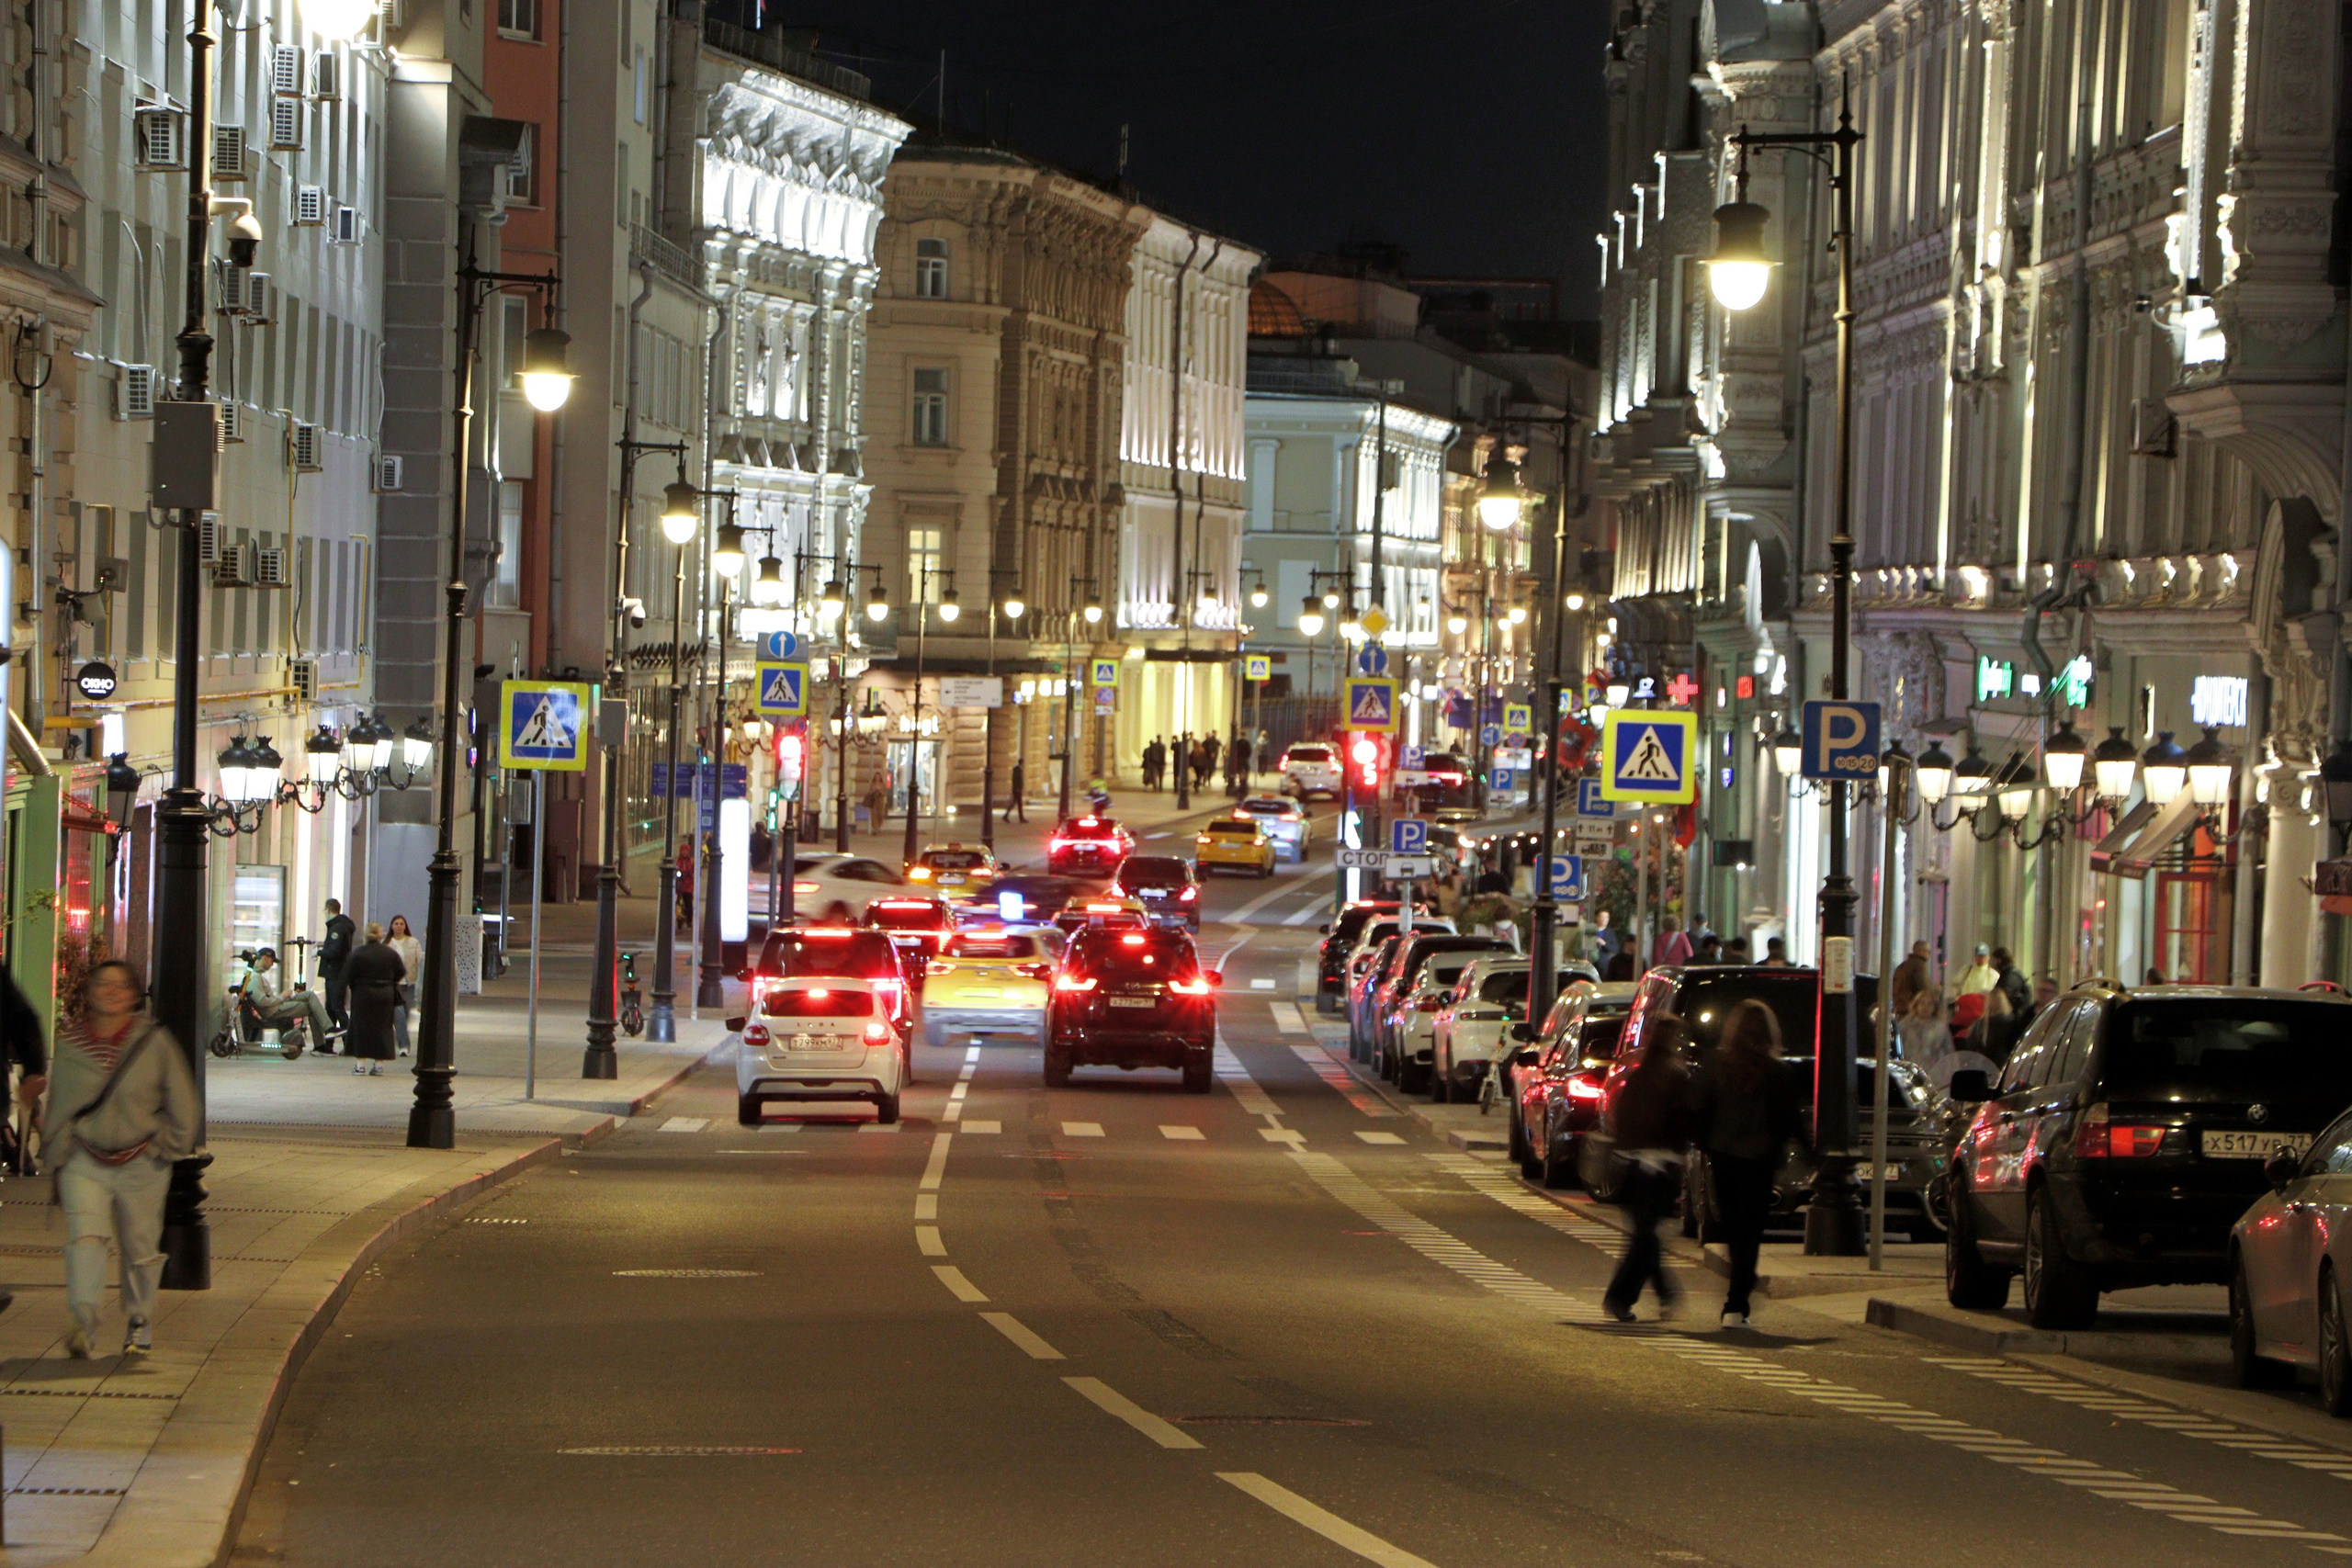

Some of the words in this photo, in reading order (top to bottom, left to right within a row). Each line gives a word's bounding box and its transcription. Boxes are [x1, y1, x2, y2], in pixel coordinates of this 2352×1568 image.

[1819, 705, 1867, 773] P
[1860, 758, 1875, 769] 20
[1401, 823, 1420, 850] P
[1342, 852, 1390, 866] СТОП
